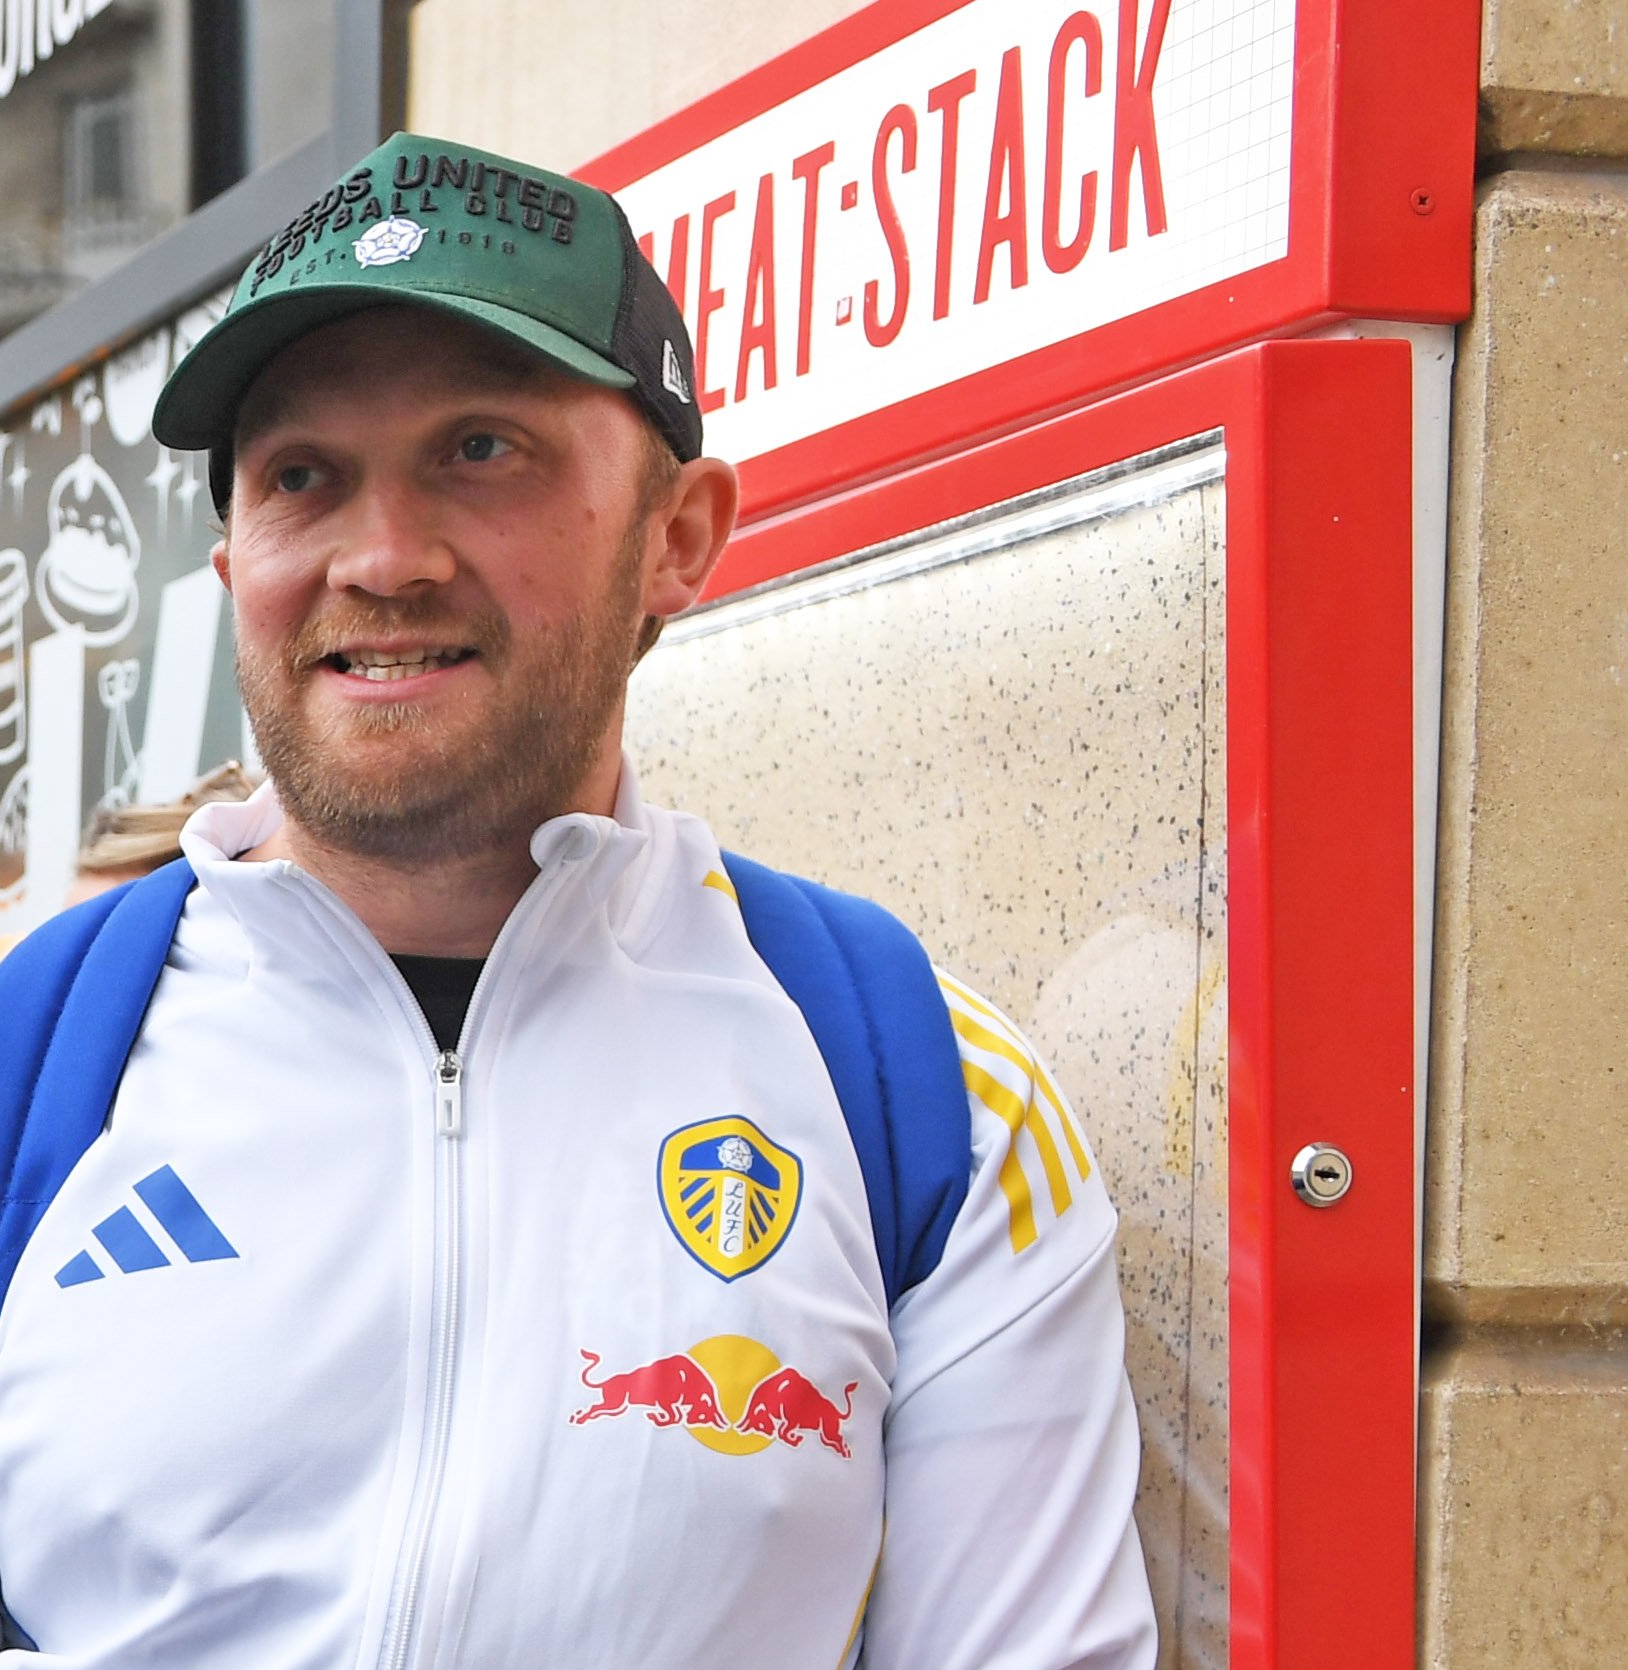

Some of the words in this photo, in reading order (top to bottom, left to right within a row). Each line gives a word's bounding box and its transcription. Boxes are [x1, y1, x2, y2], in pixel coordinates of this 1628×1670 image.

[393, 154, 578, 222] UNITED
[639, 0, 1169, 416] EAT:STACK
[250, 187, 439, 297] FOOTBALL
[464, 190, 573, 245] CLUB
[290, 248, 346, 285] EST.
[723, 1181, 744, 1253] LUFC
